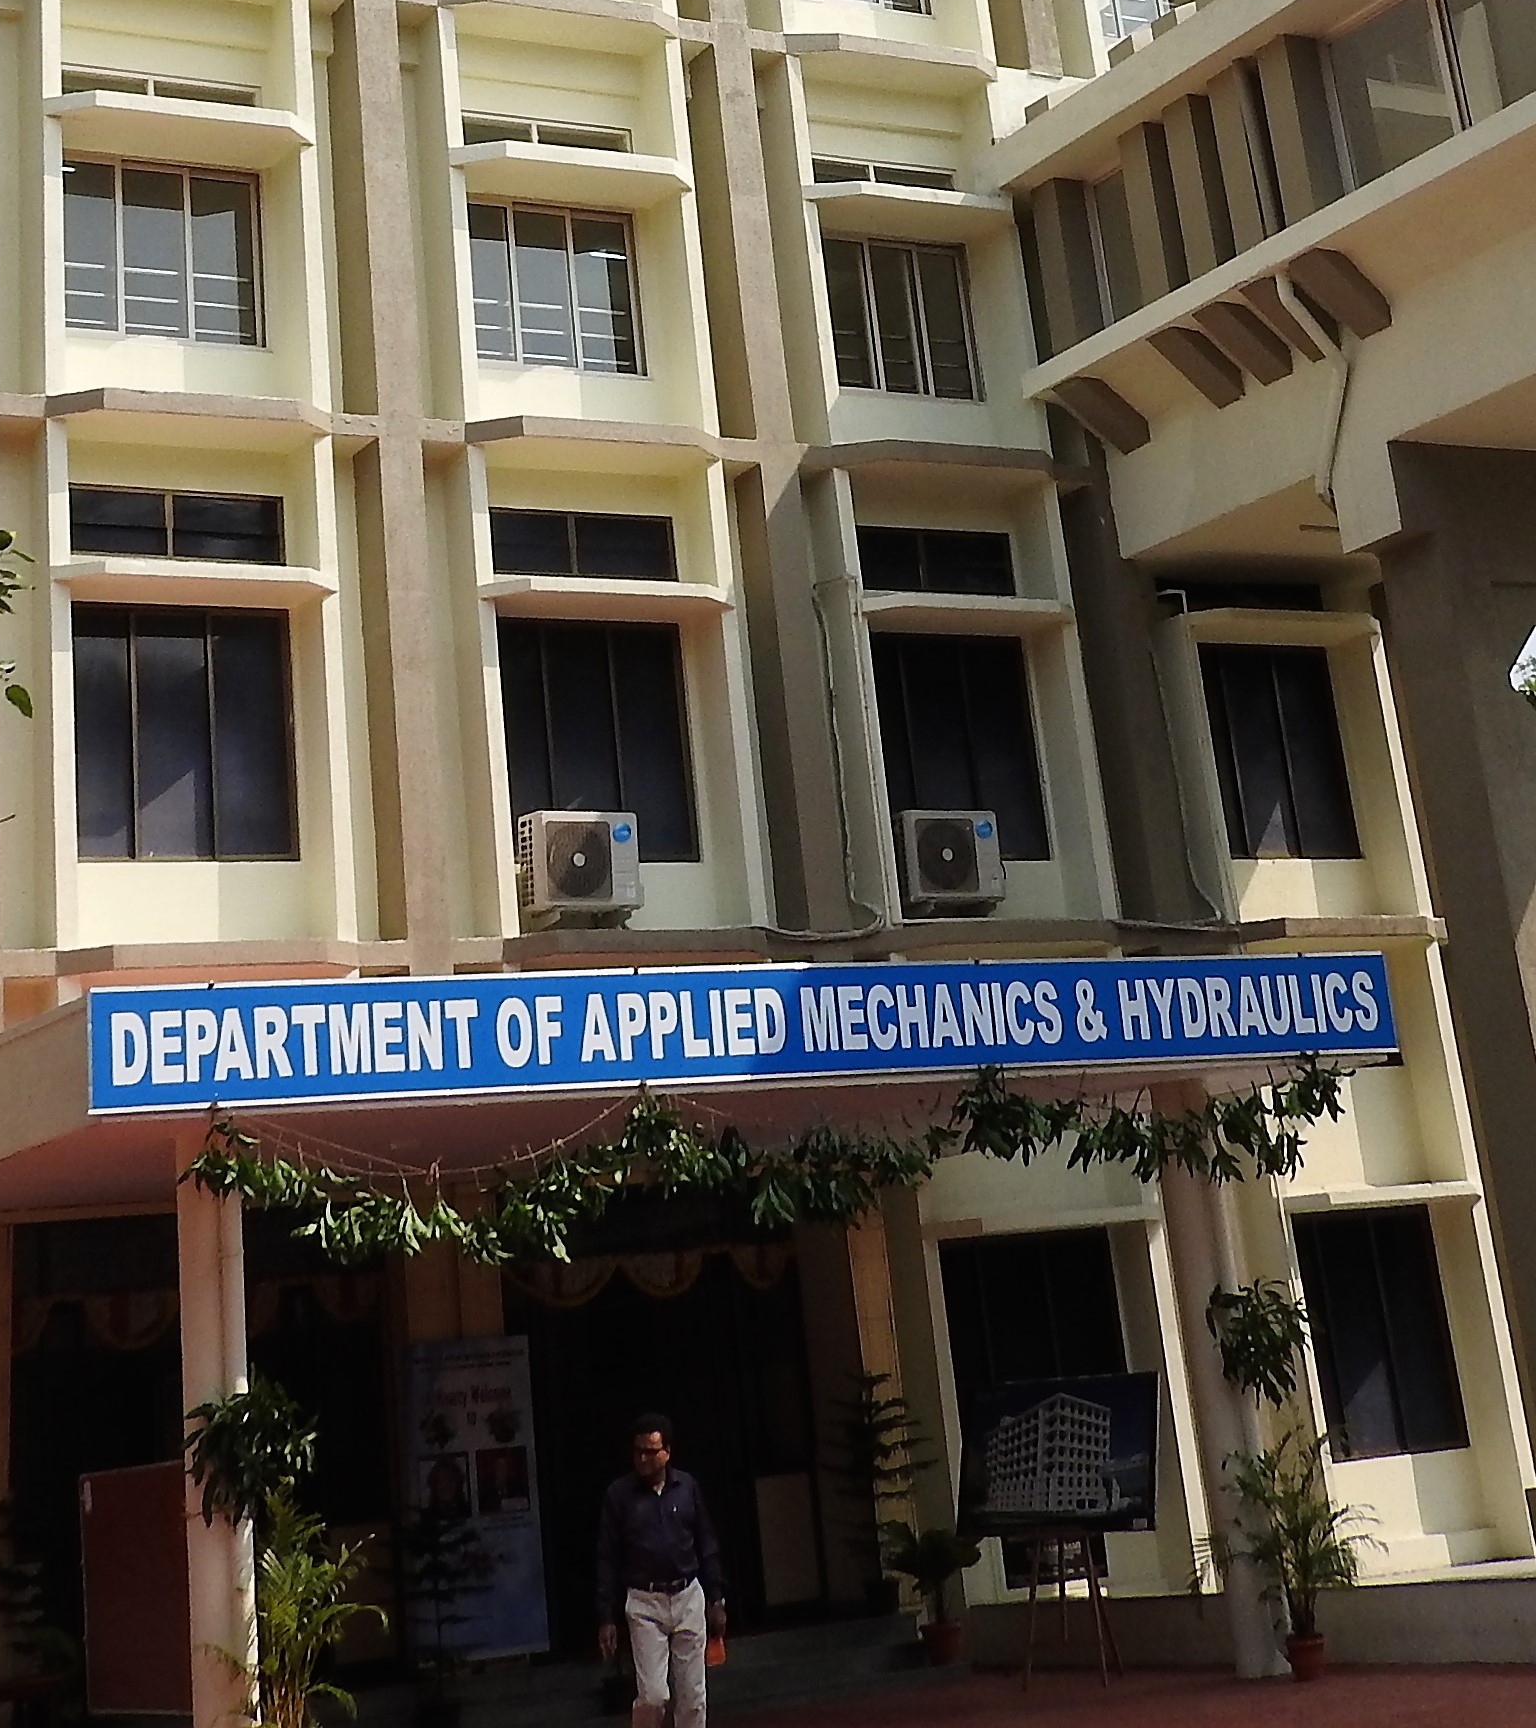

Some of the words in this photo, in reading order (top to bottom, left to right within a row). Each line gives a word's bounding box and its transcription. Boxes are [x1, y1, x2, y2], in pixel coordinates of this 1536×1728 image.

[110, 998, 479, 1087] DEPARTMENT
[496, 995, 562, 1068] OF
[580, 987, 786, 1062] APPLIED
[799, 980, 1063, 1052] MECHANICS
[1075, 979, 1108, 1043] &
[1117, 971, 1379, 1041] HYDRAULICS
